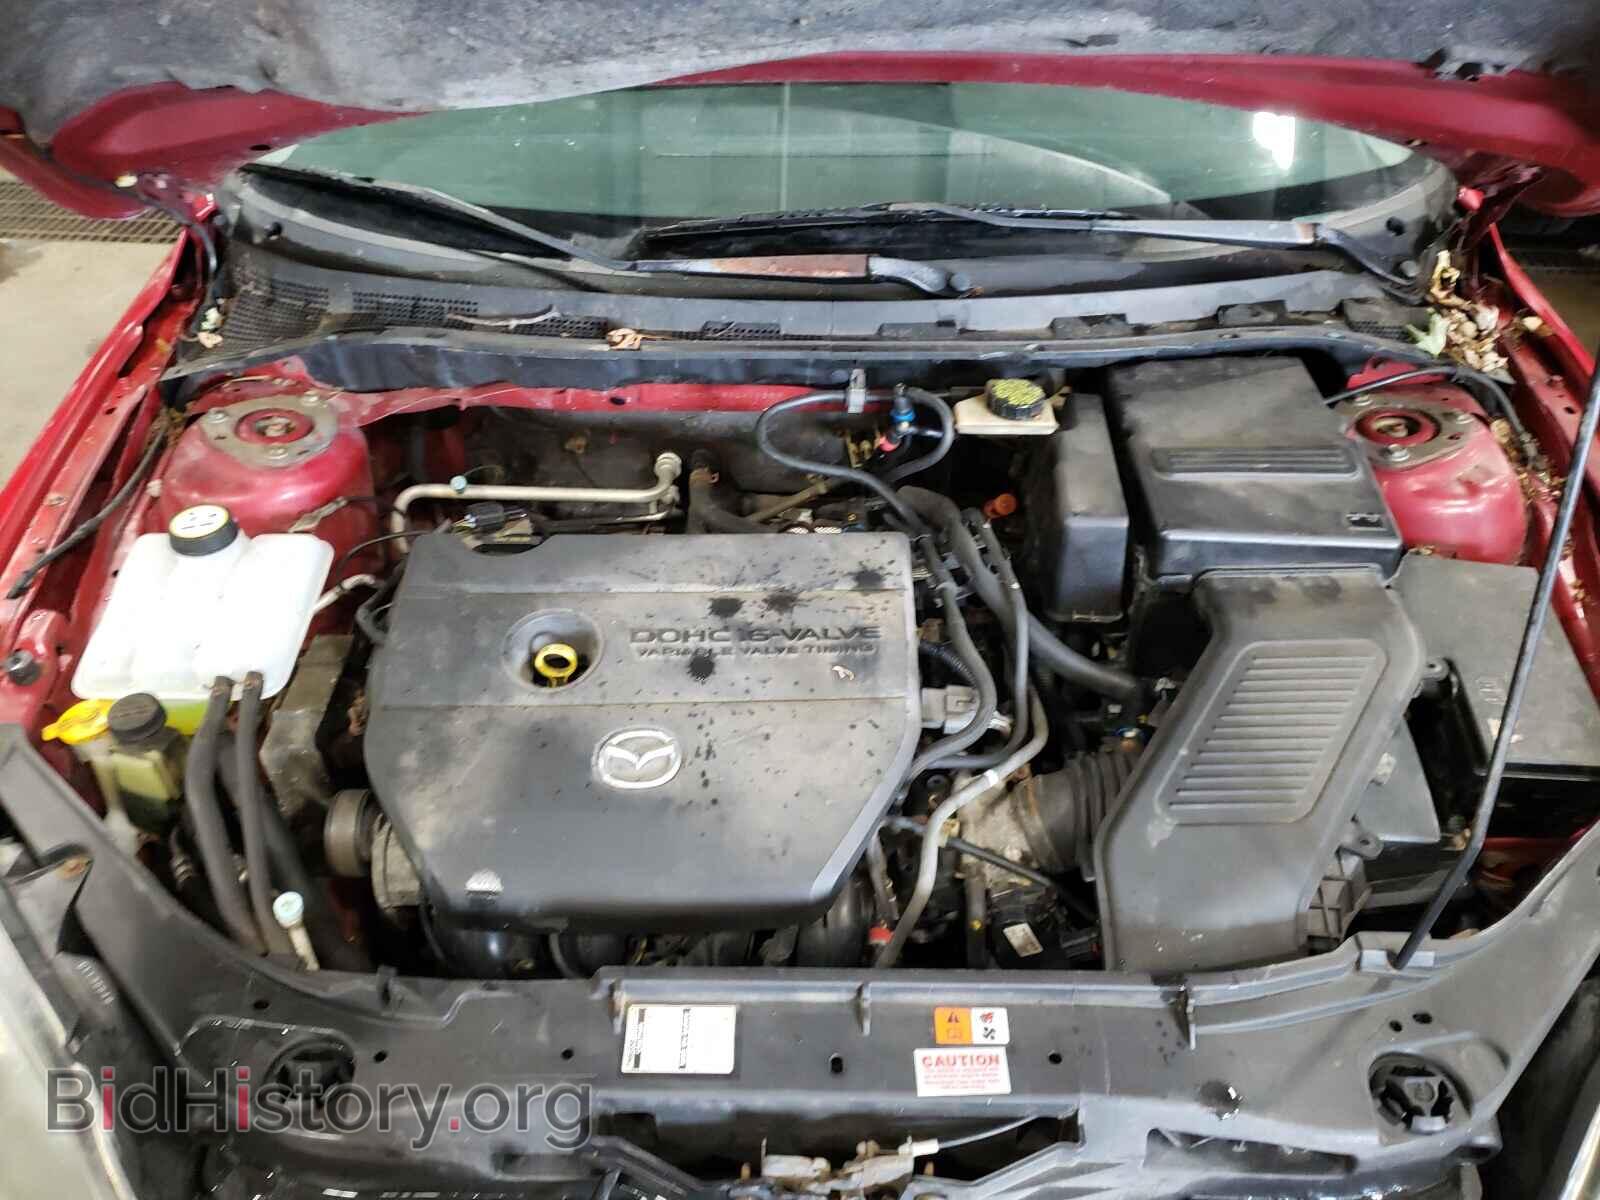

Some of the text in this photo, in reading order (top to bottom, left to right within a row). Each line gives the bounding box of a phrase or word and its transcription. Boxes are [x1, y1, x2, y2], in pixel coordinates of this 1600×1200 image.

[630, 627, 731, 643] DOHC
[742, 645, 800, 656] VALVE
[922, 1053, 1000, 1067] CAUTION
